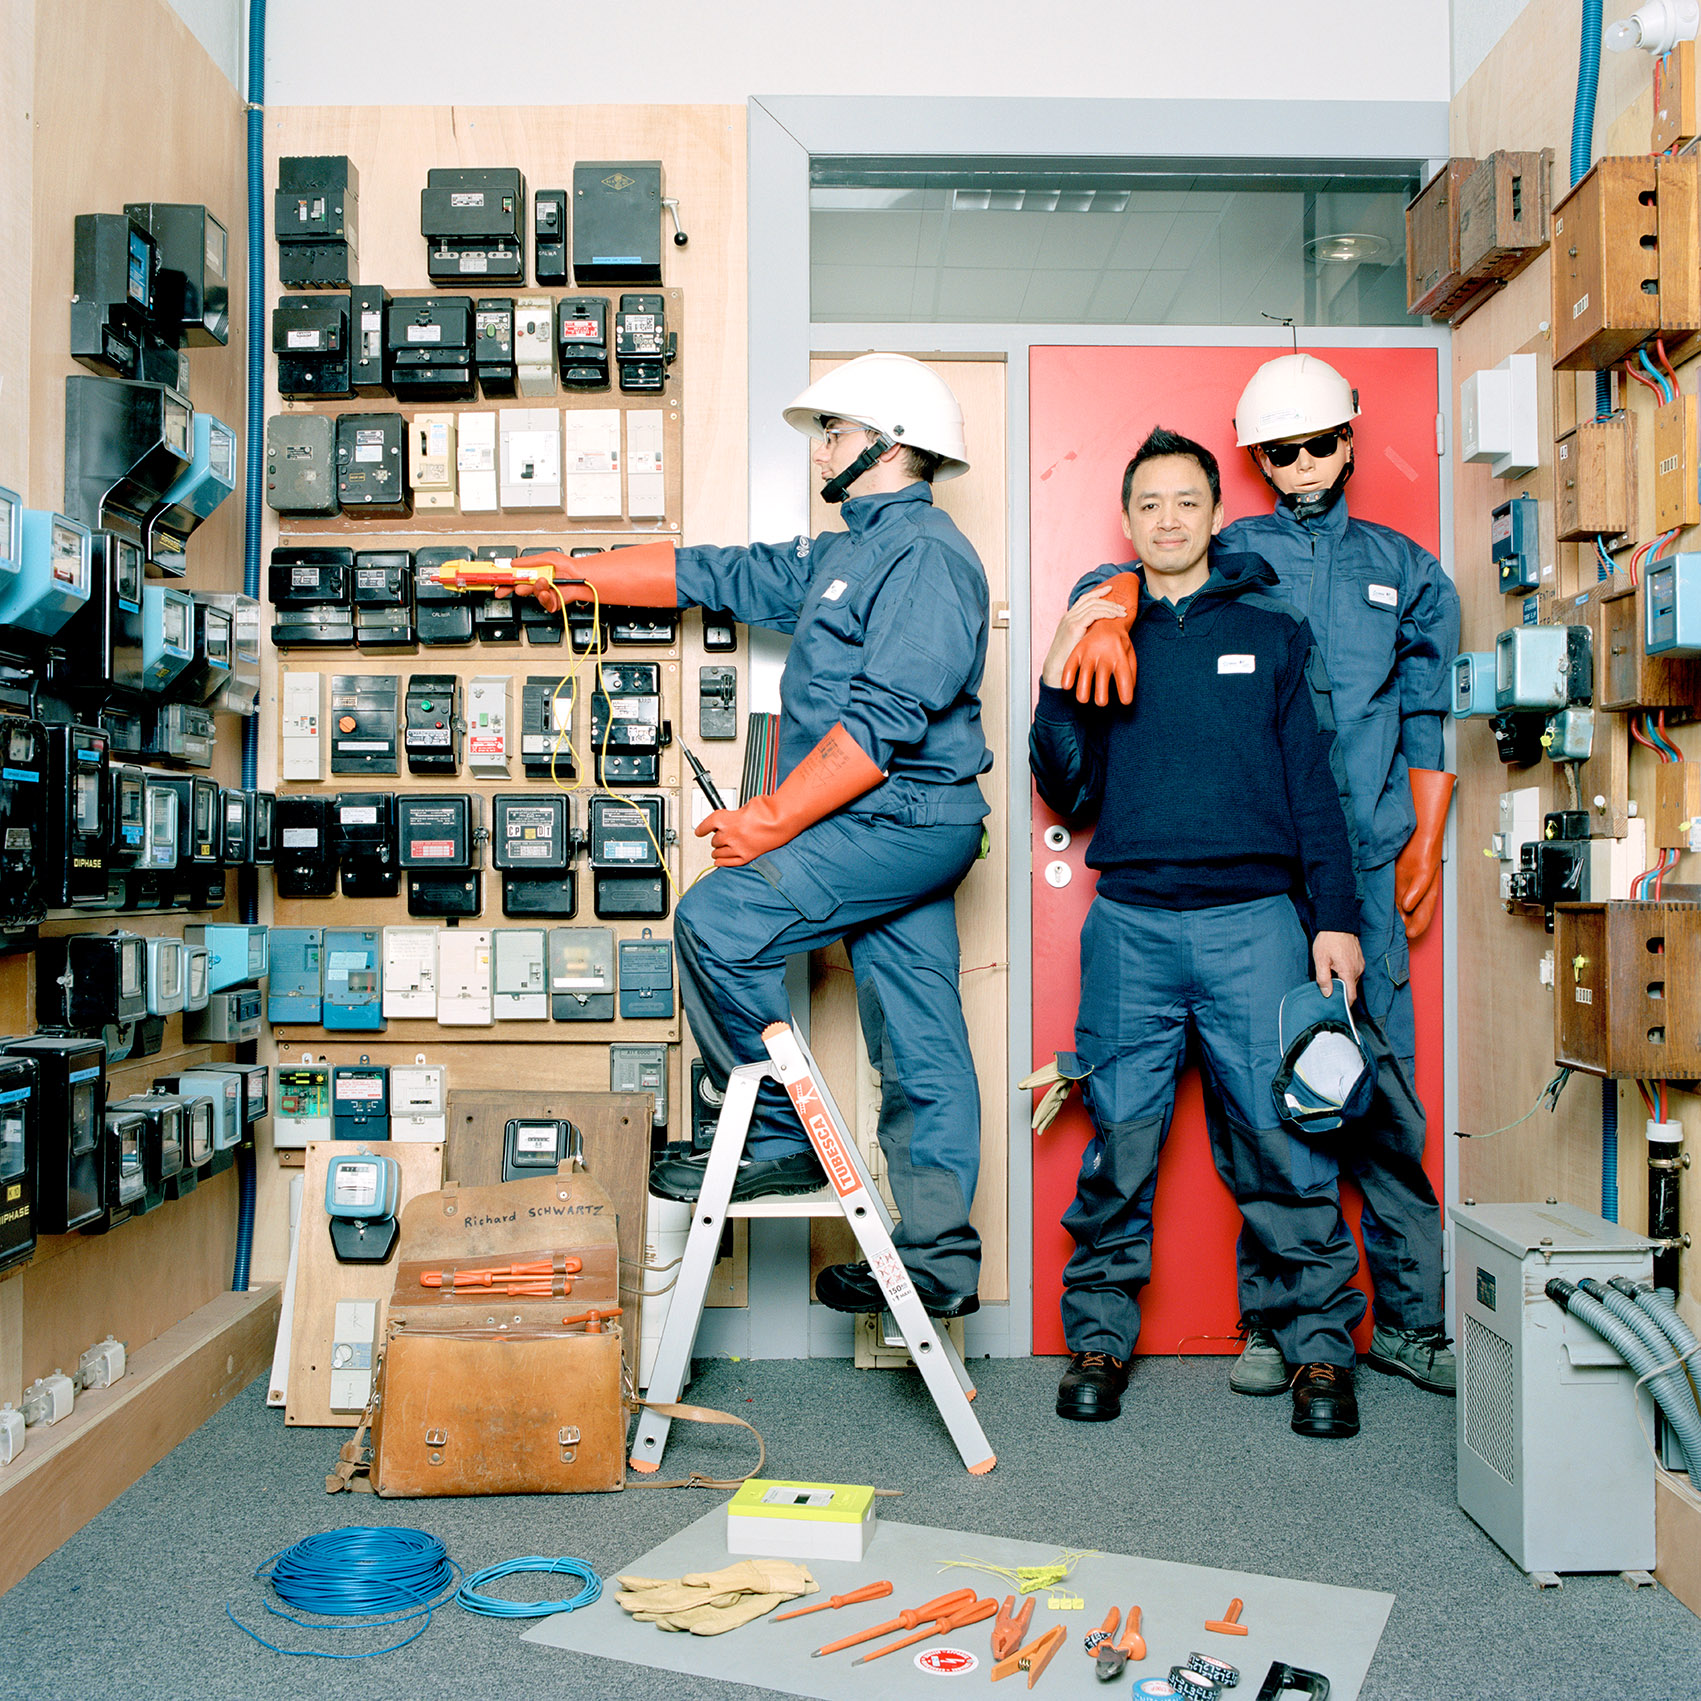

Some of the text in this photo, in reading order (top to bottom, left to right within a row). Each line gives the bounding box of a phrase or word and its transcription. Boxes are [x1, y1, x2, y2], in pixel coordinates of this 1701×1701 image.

[73, 858, 102, 869] DIPHASE
[813, 1118, 852, 1187] TUBESCA
[464, 1205, 604, 1228] Richard SCHWARTZ
